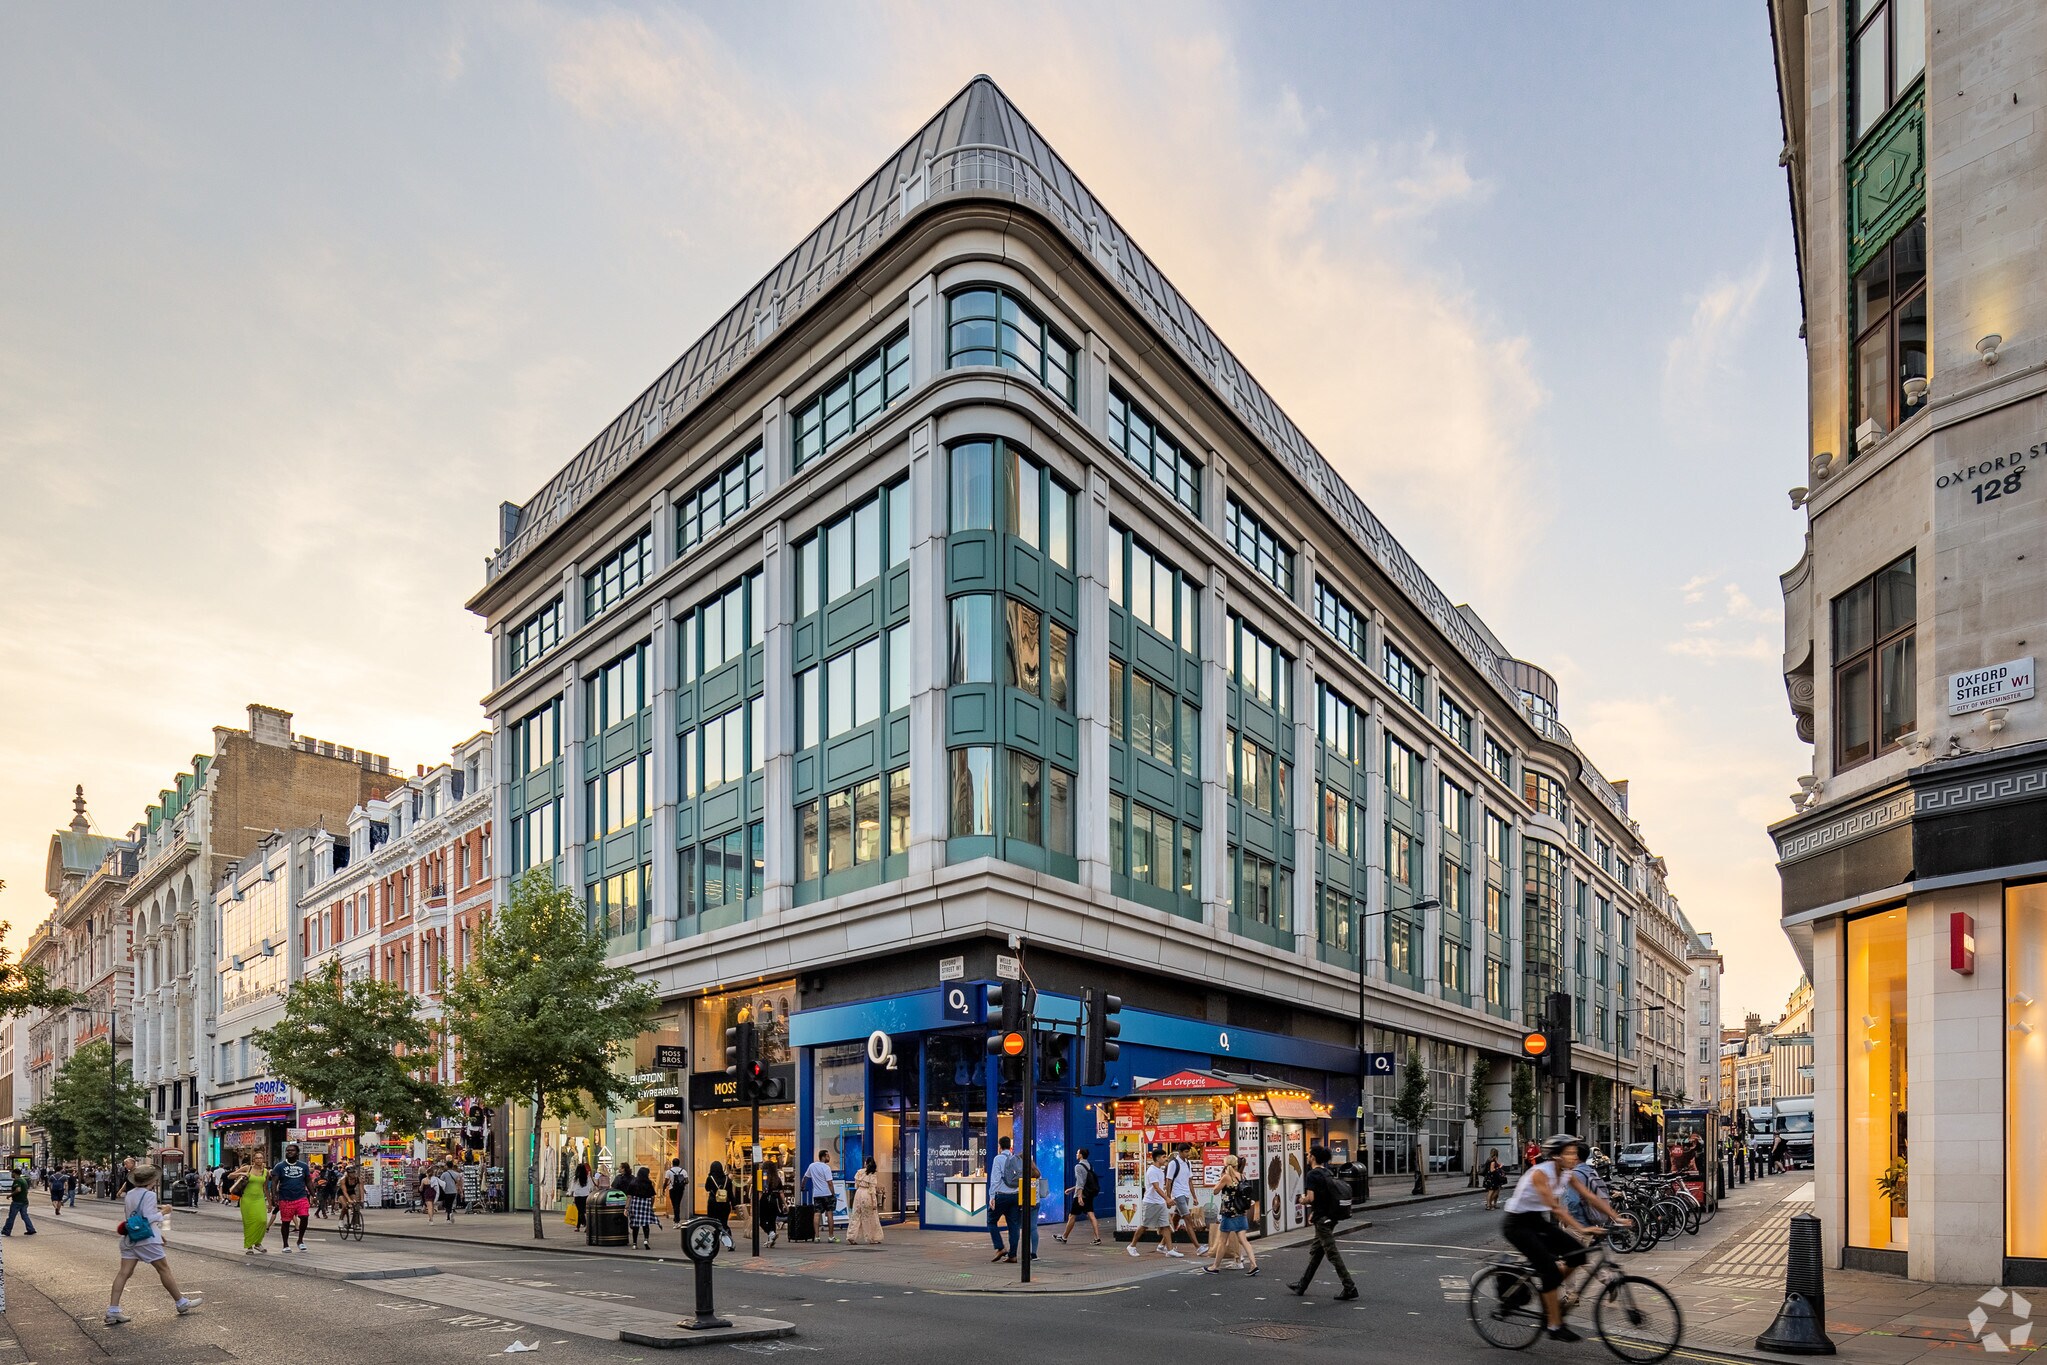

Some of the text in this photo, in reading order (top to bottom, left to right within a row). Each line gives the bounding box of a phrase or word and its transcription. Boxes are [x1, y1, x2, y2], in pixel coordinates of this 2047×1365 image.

[1936, 452, 2022, 488] OXFORD
[1971, 473, 2022, 505] 128
[1957, 667, 2007, 688] OXFORD
[1957, 674, 2029, 700] STREET W1
[1956, 703, 1970, 711] CITY
[1979, 692, 2021, 706] WESTMINSTER
[941, 966, 955, 974] STREET
[949, 989, 968, 1014] O2
[868, 1030, 898, 1070] O2
[1220, 1032, 1230, 1051] O2
[1375, 1056, 1391, 1072] O2
[254, 1081, 287, 1094] SPORTS
[714, 1081, 738, 1095] MOSS
[1174, 1076, 1206, 1087] Creperie
[1267, 1144, 1282, 1153] WAFFLE
